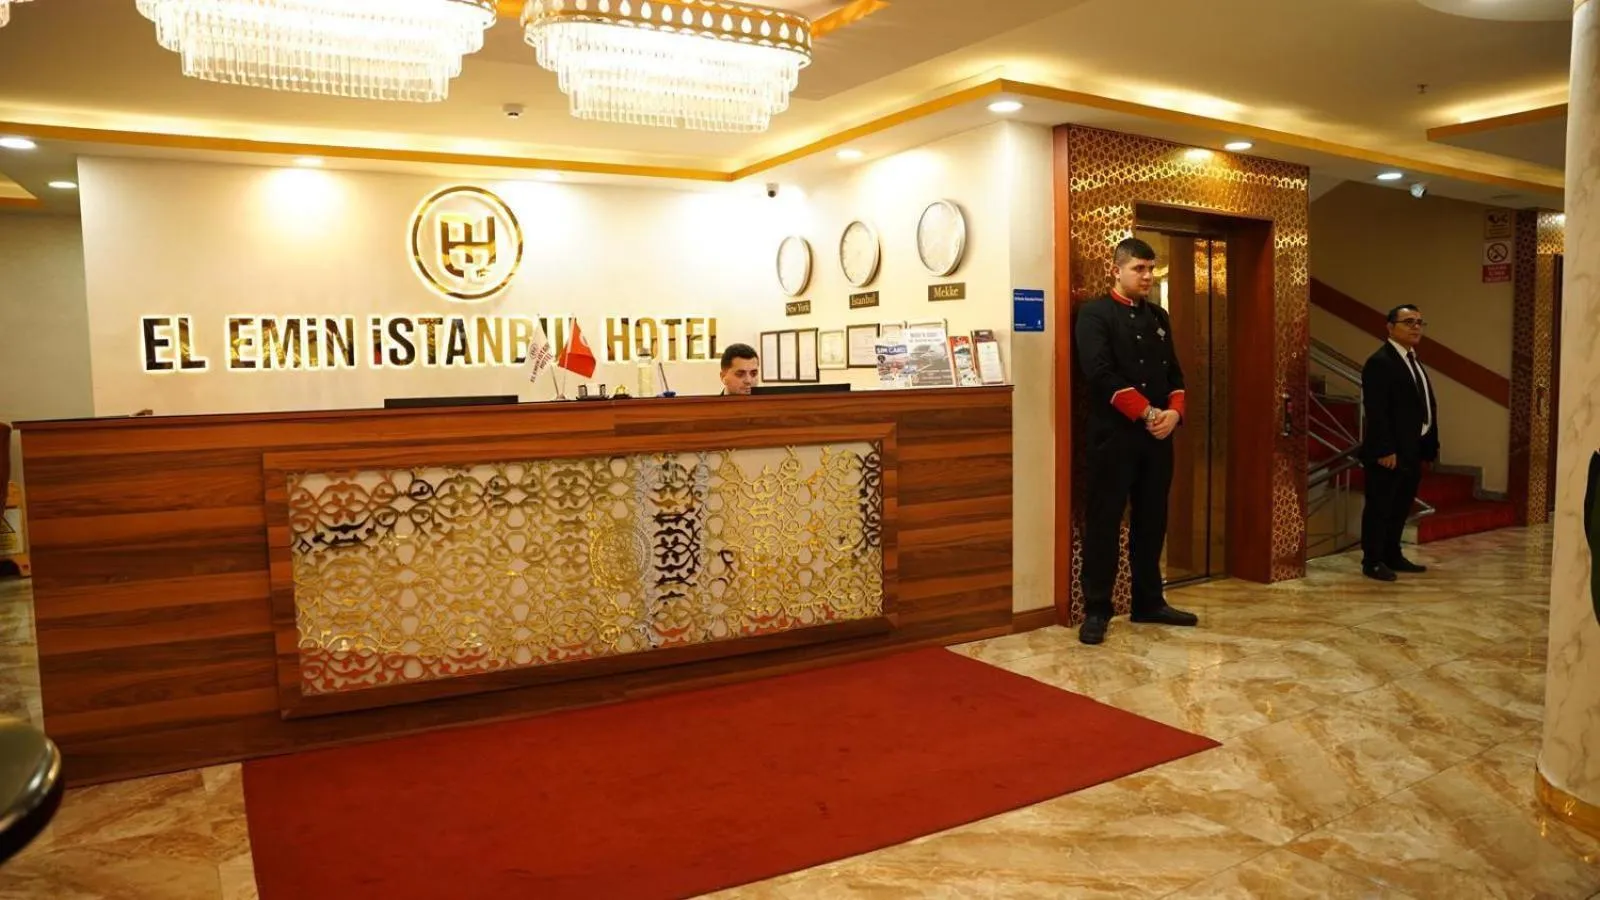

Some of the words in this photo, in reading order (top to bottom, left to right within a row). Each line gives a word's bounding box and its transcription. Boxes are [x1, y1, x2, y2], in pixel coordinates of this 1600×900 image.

[934, 286, 959, 298] Mekke
[142, 317, 206, 371] EL
[606, 316, 723, 362] HOTEL
